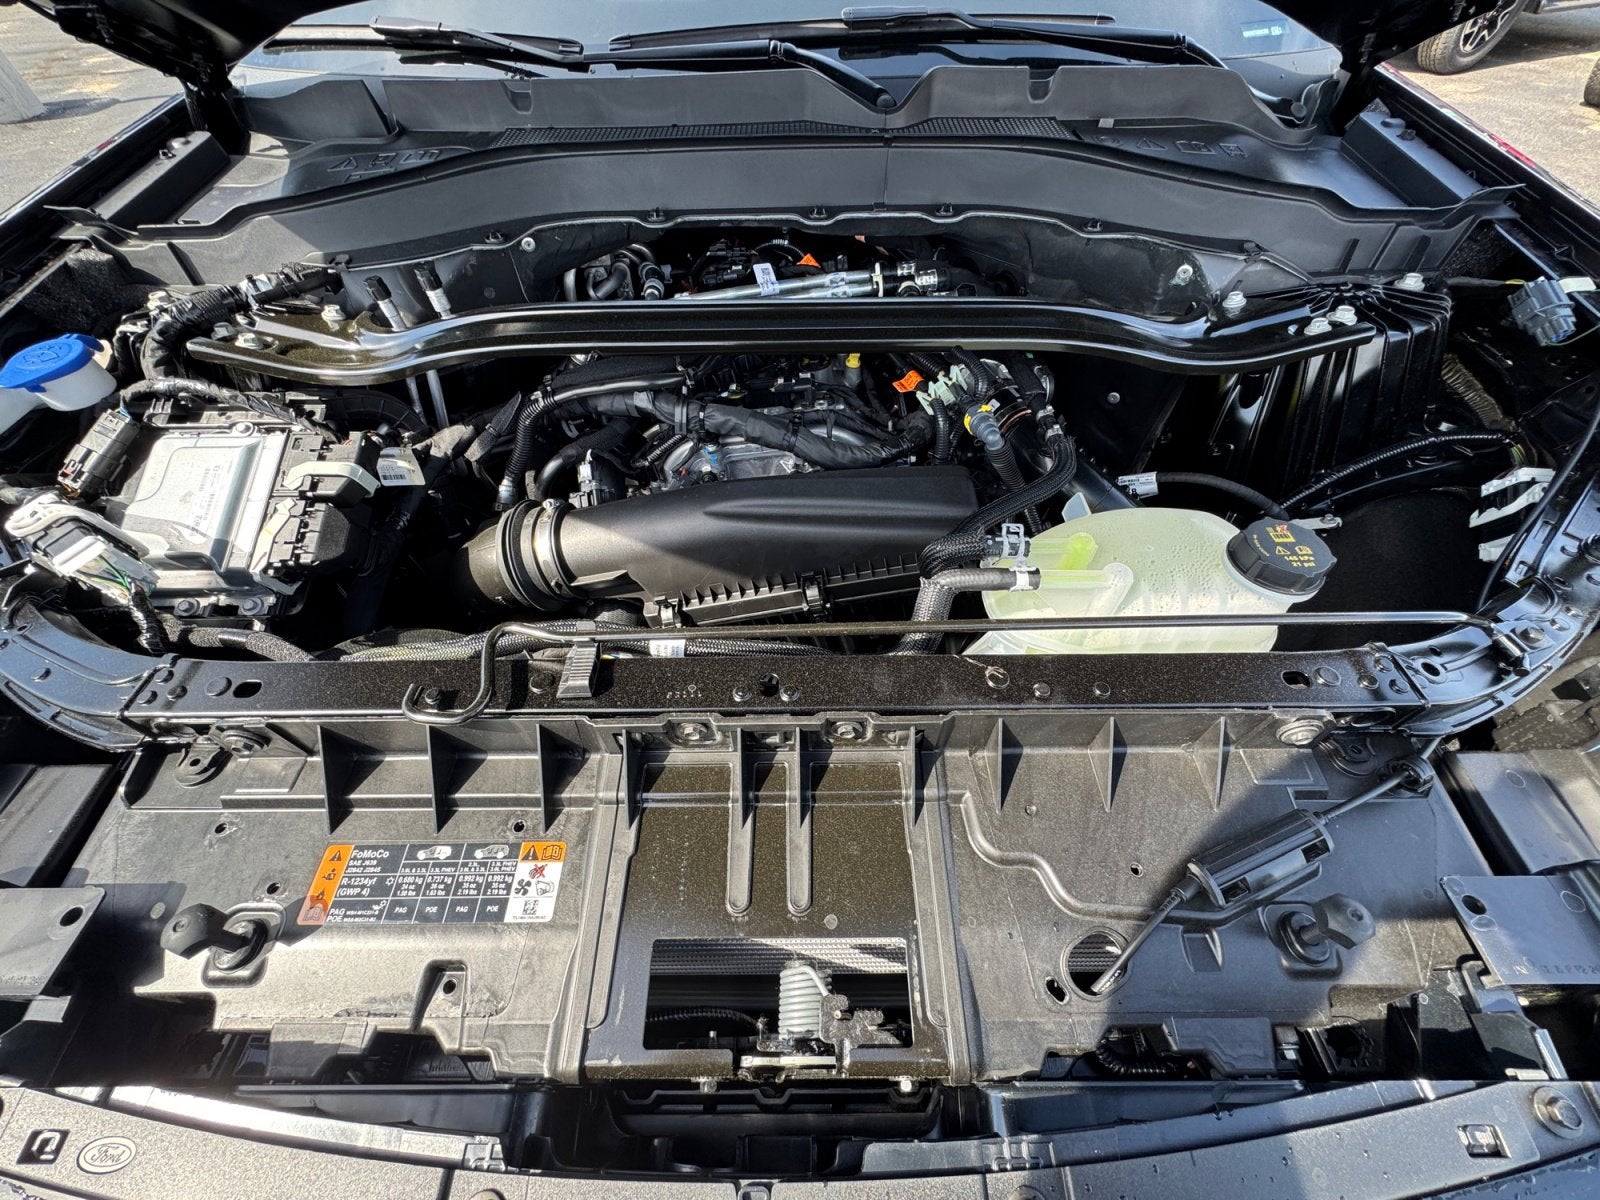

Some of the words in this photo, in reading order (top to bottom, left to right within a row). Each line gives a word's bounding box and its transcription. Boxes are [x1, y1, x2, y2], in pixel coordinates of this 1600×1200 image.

[351, 849, 390, 858] FoMoCo
[341, 877, 377, 886] R-1234yf
[415, 876, 424, 884] kg
[444, 876, 453, 884] kg
[475, 875, 484, 883] kg
[504, 875, 513, 883] kg
[337, 888, 360, 897] (GWP
[361, 888, 370, 897] 4)
[90, 1146, 126, 1163] Ford
